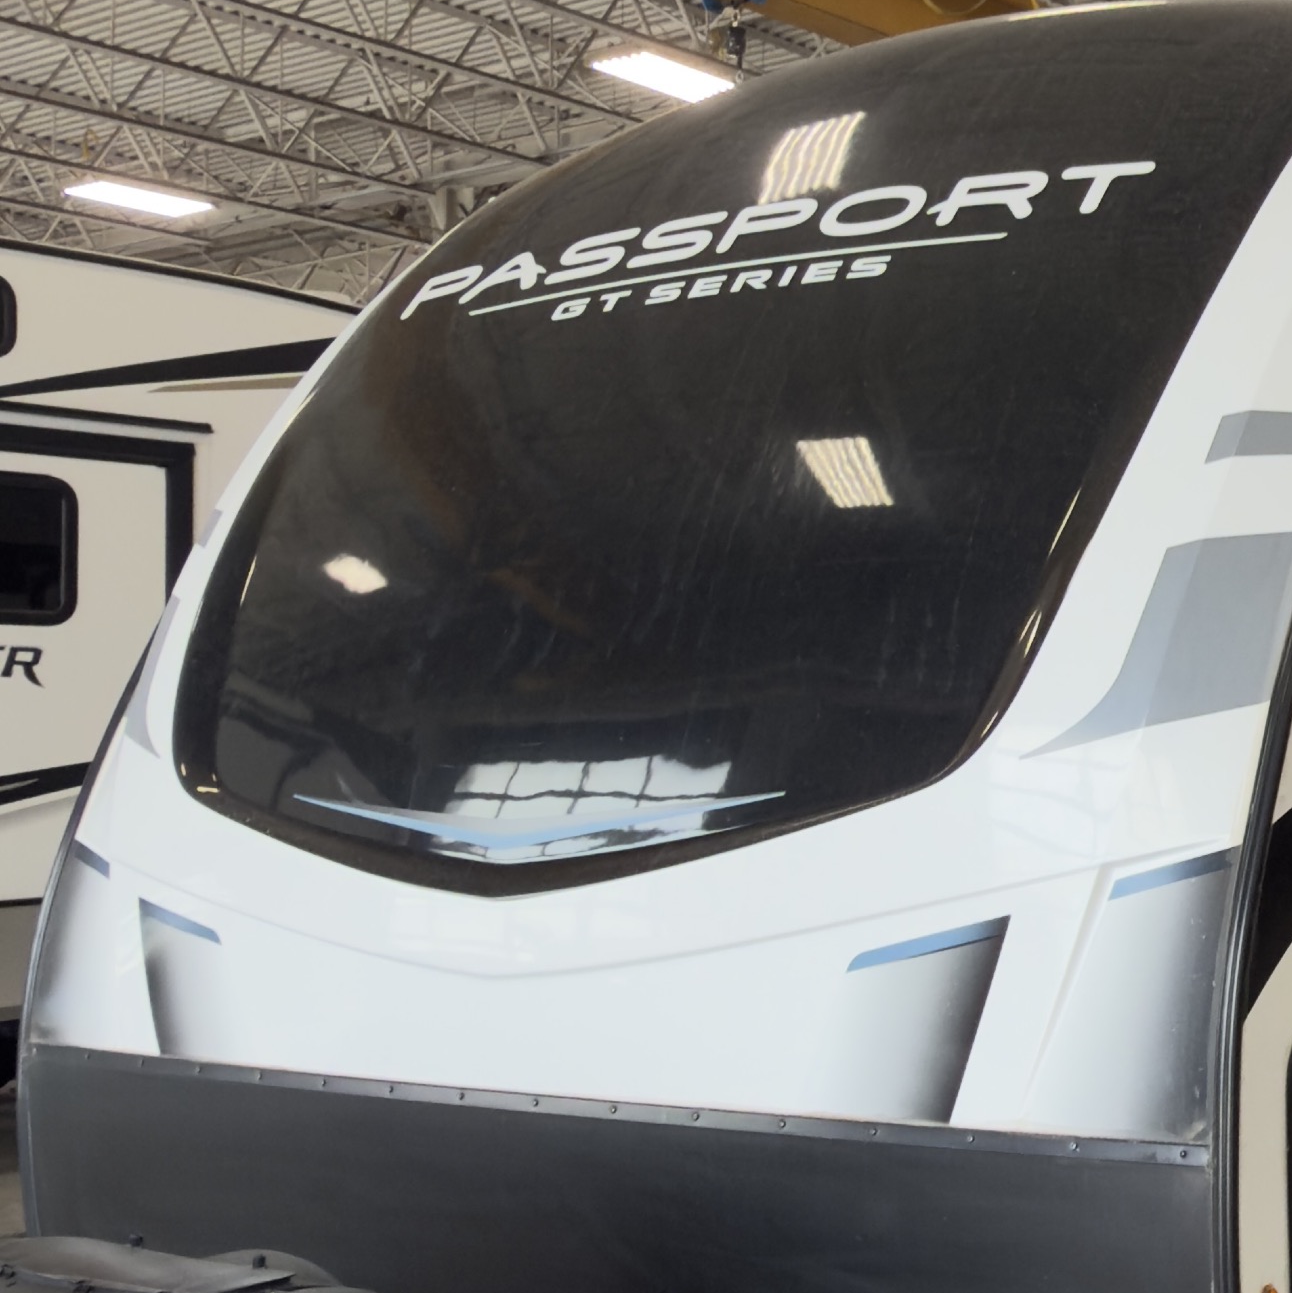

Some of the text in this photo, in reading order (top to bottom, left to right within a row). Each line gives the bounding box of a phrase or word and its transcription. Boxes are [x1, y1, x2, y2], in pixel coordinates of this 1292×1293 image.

[400, 160, 1156, 321] PASSPORT
[551, 255, 892, 321] GT SERIES
